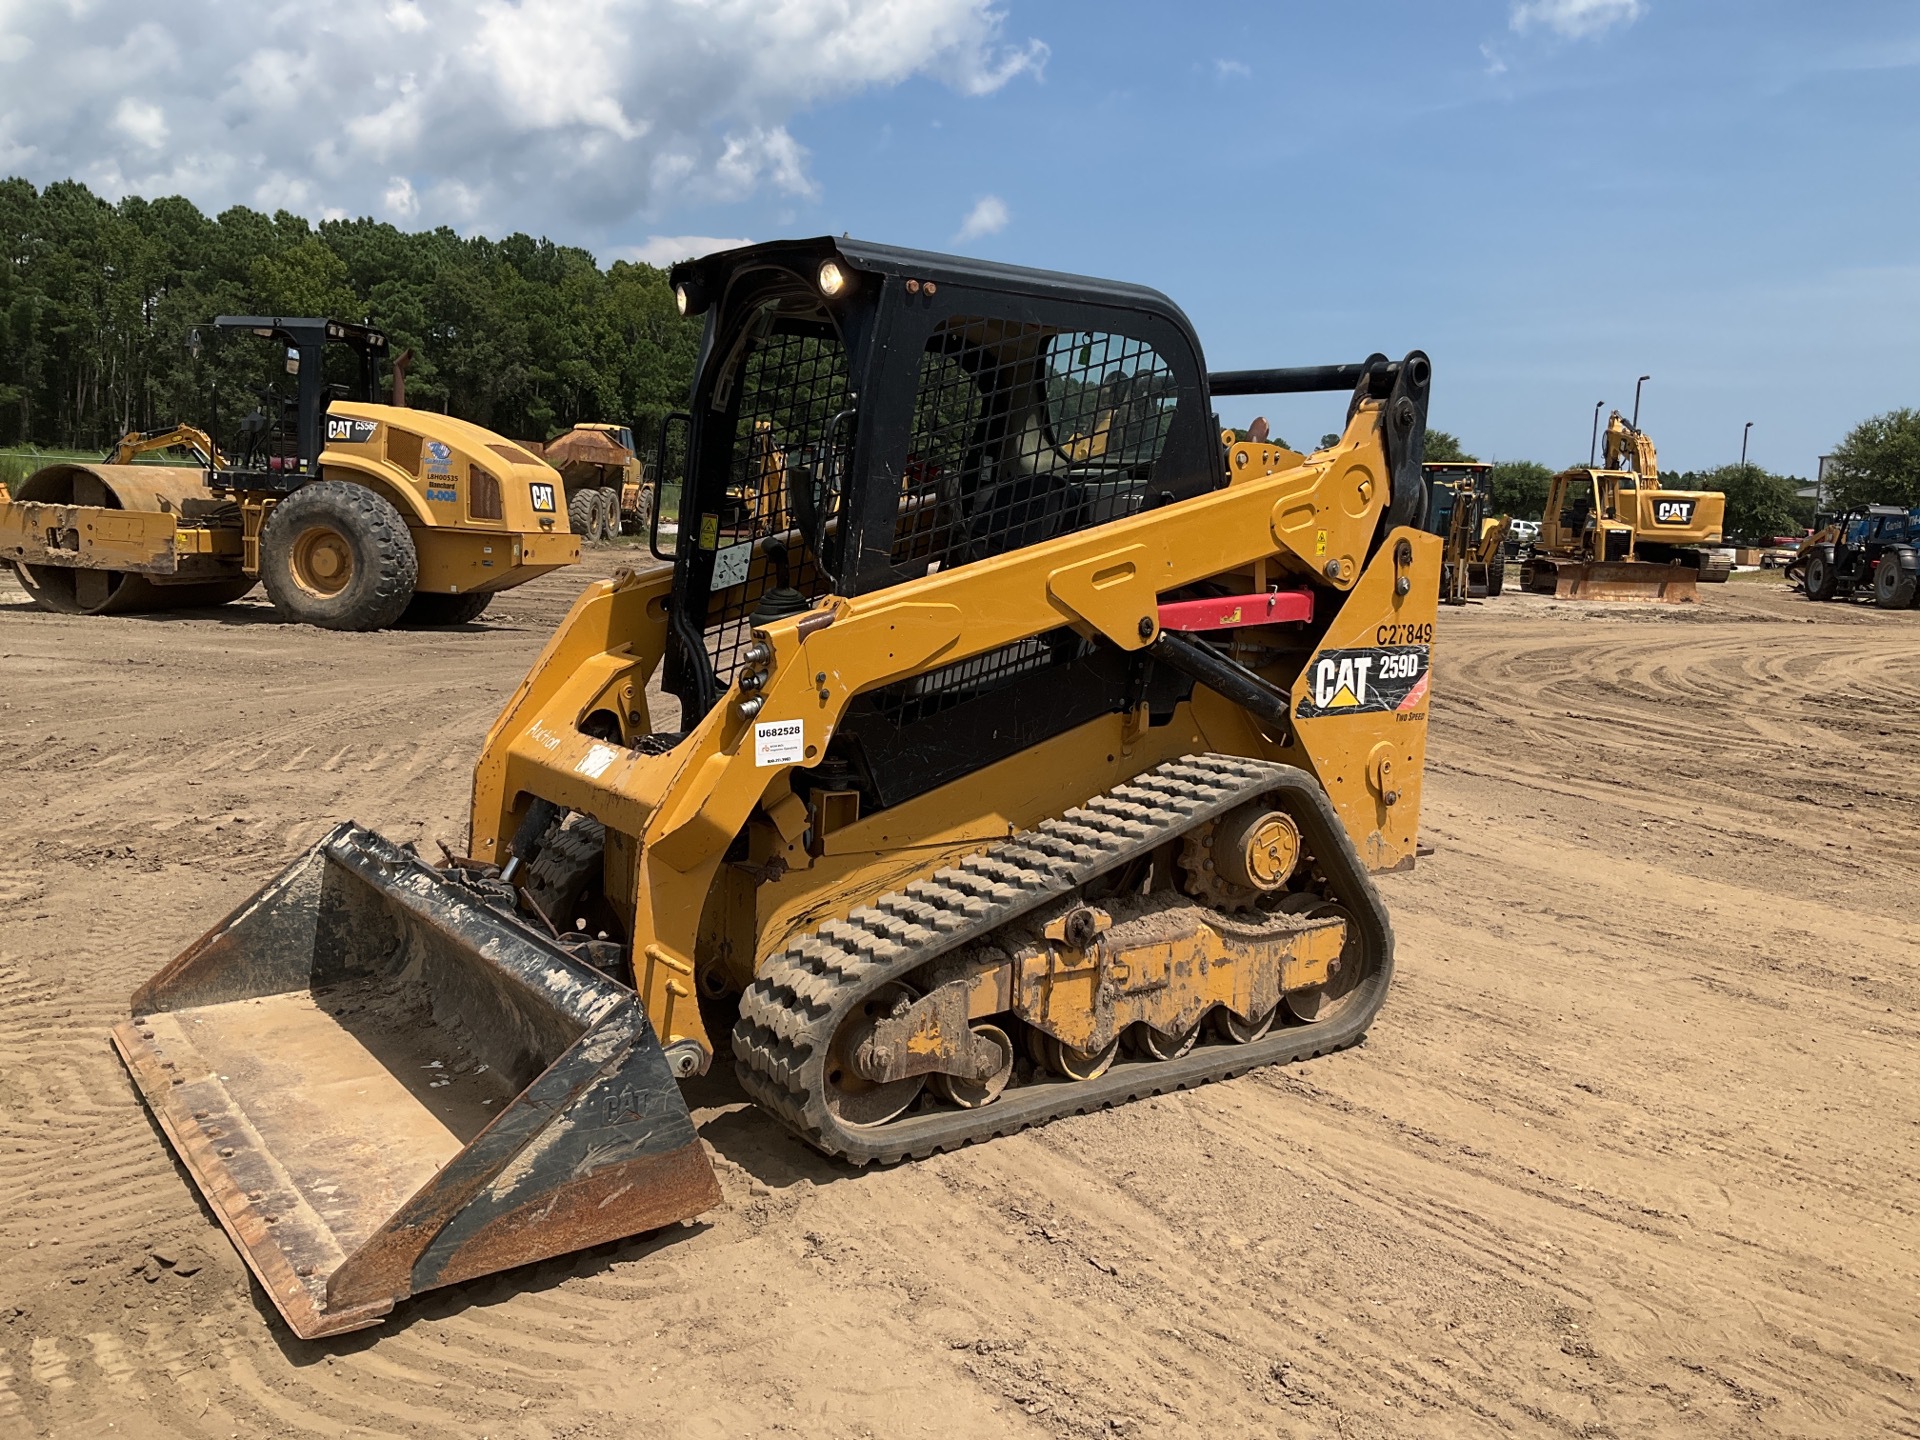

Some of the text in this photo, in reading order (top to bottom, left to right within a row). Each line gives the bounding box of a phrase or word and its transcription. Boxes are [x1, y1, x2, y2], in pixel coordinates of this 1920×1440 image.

[328, 420, 352, 439] CAT
[532, 485, 553, 510] CAT
[1659, 502, 1691, 522] CAT
[1376, 623, 1432, 646] C27849
[1315, 654, 1418, 709] CAT 259D
[525, 719, 561, 752] Auction
[758, 726, 801, 738] U682528
[602, 1088, 650, 1126] CAT
